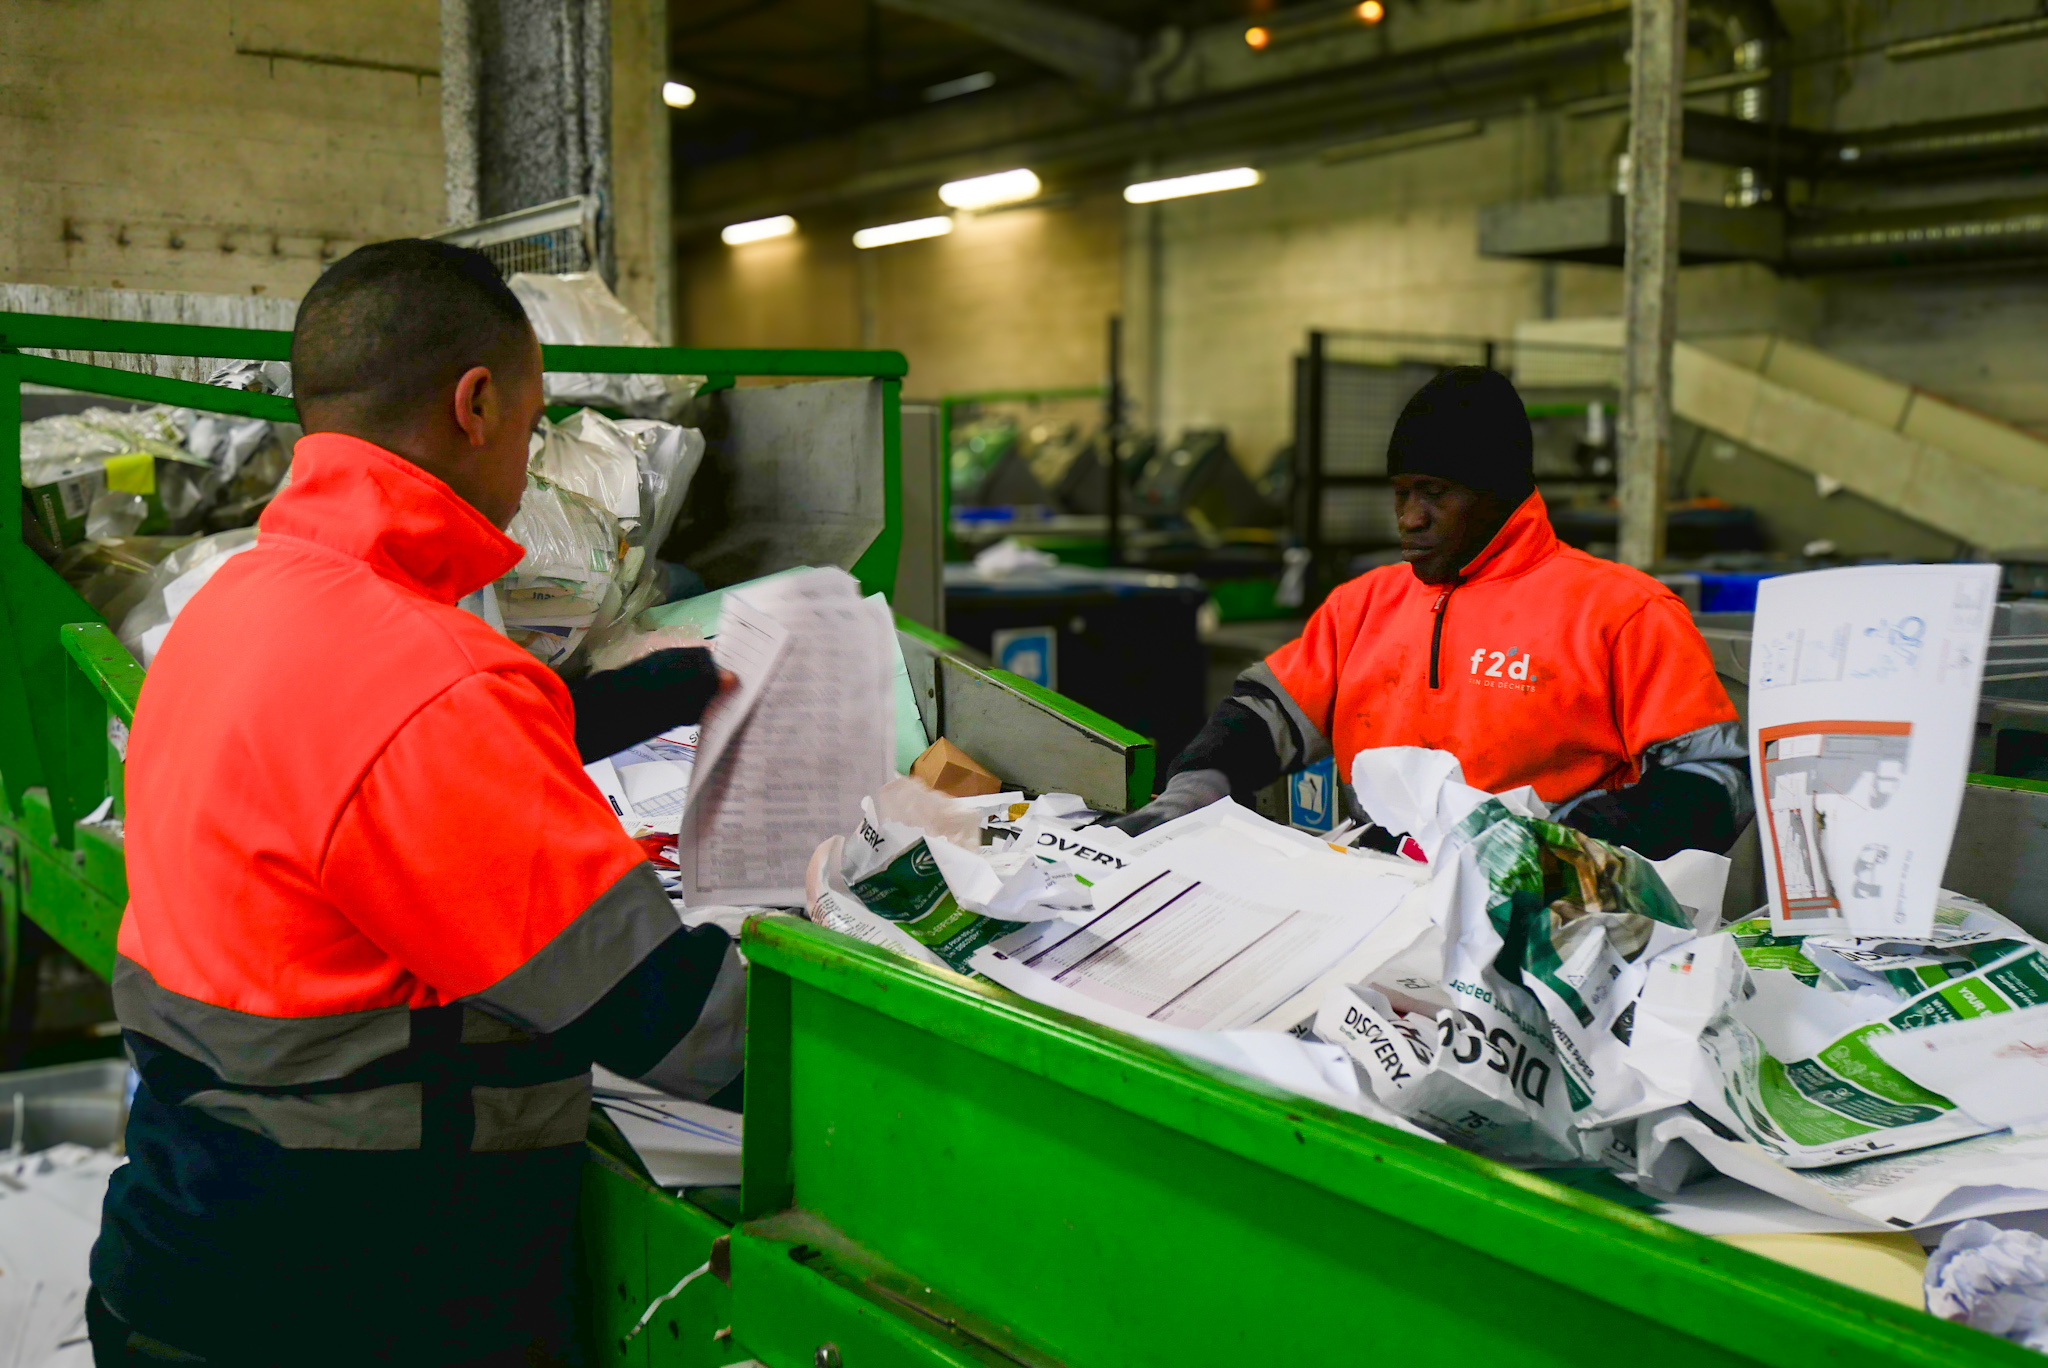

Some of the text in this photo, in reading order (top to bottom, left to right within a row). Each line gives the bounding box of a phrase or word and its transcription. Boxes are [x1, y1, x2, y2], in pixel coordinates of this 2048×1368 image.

[1468, 678, 1481, 686] FIN
[1484, 679, 1495, 688] DE
[689, 731, 700, 744] S
[860, 818, 885, 849] VERY
[1037, 832, 1131, 870] OVERY
[1449, 978, 1492, 1004] paper
[1958, 986, 1986, 1012] YOUR
[1922, 1003, 1935, 1015] TO
[1931, 999, 1950, 1015] WHY
[1550, 1019, 1574, 1052] WHITE
[1572, 1048, 1595, 1079] PAPER
[1457, 1110, 1489, 1130] 75
